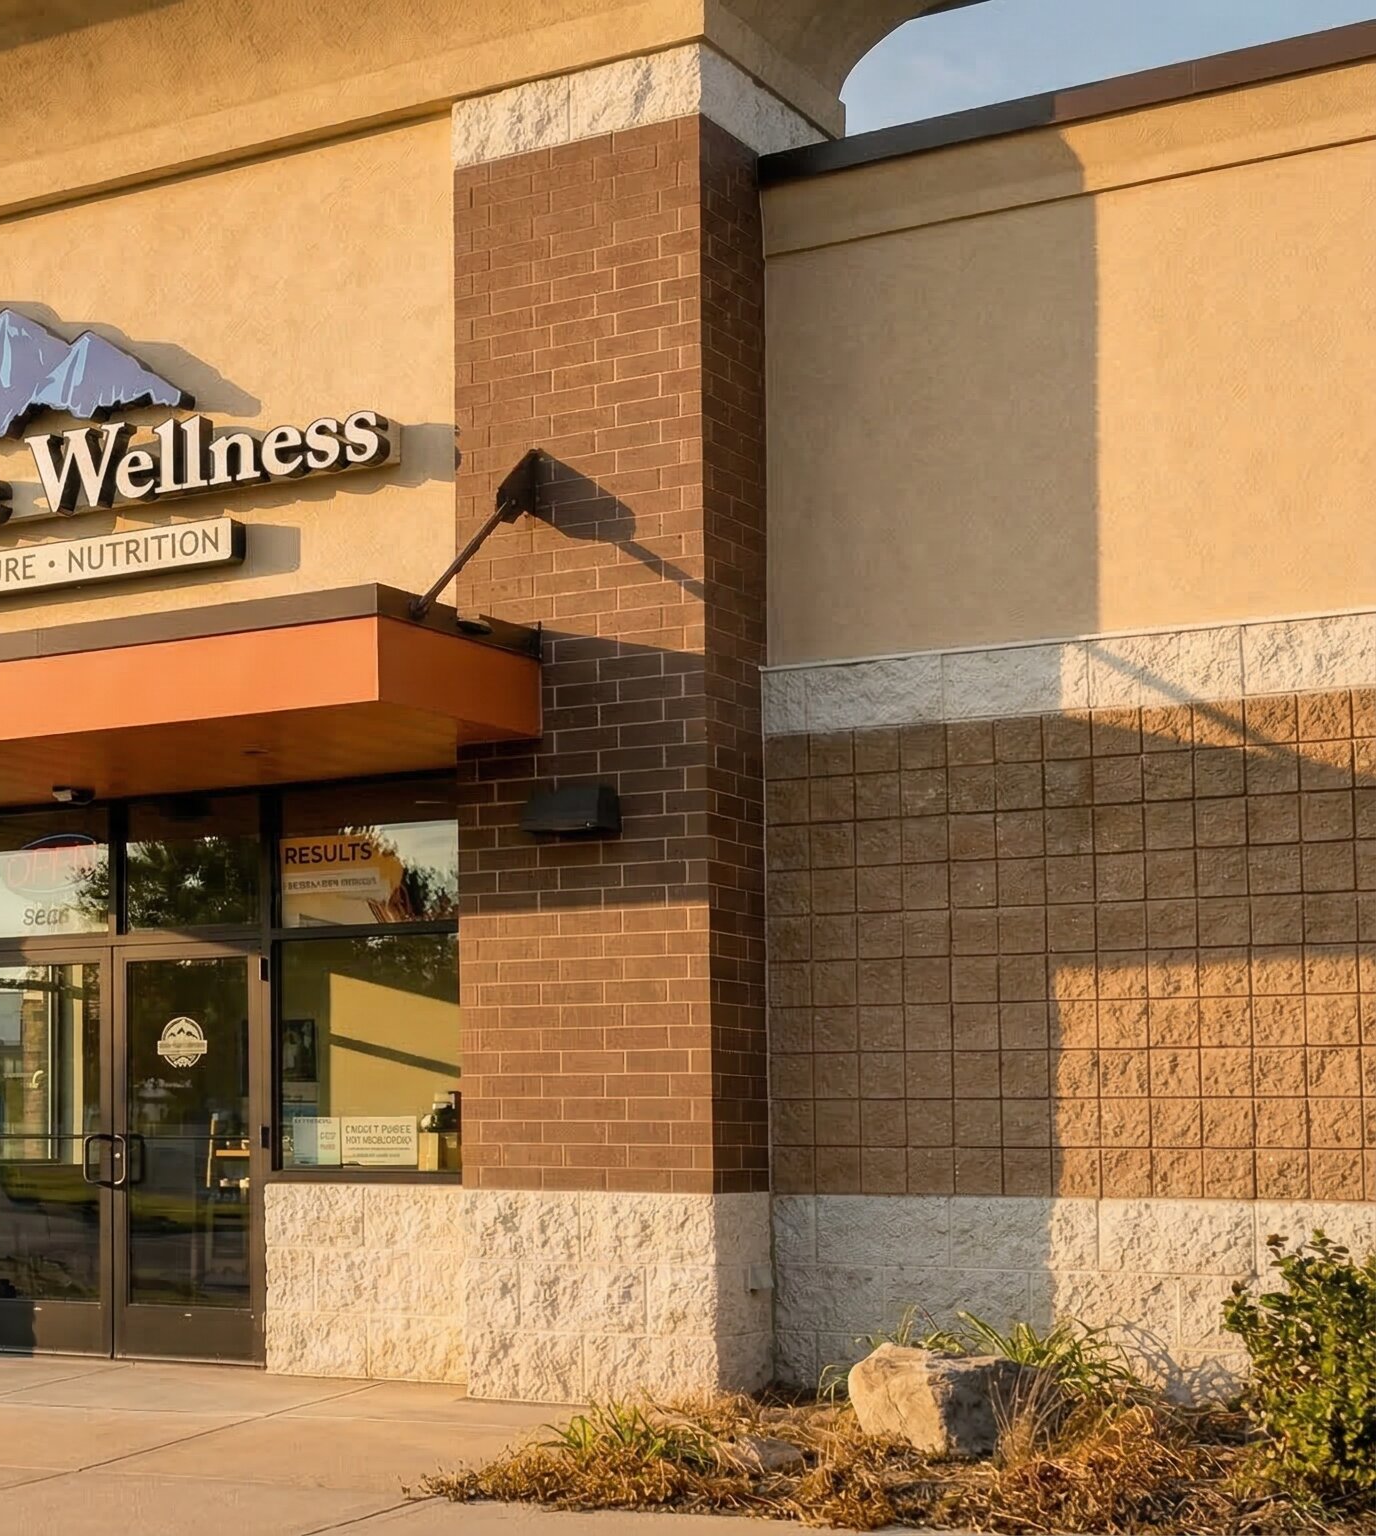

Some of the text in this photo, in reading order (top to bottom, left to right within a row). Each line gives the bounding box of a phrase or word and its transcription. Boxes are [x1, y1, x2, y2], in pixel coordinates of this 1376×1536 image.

[24, 410, 381, 513] Wellness
[67, 526, 220, 574] NUTRITION
[285, 842, 372, 865] RESULTS
